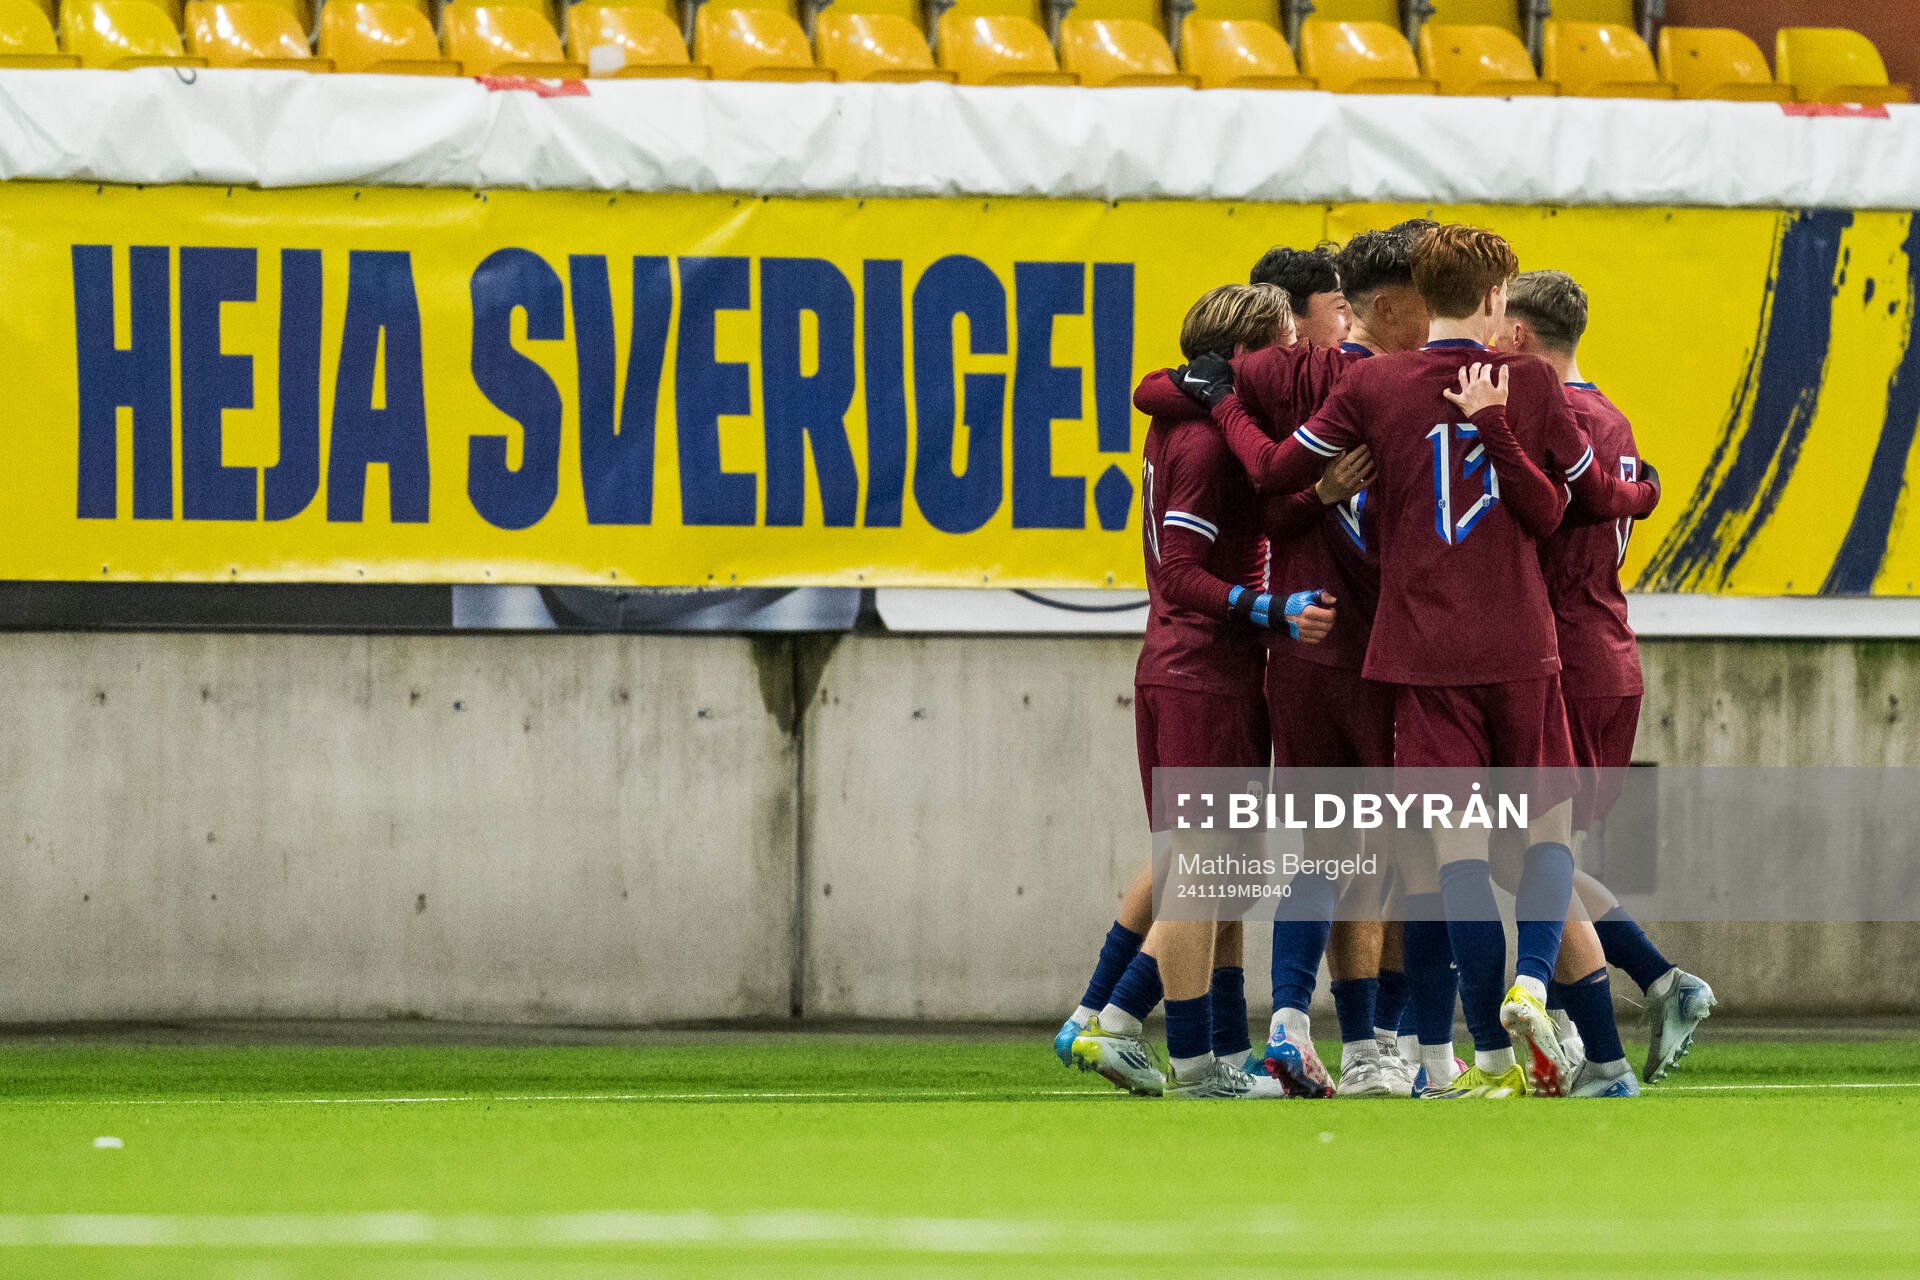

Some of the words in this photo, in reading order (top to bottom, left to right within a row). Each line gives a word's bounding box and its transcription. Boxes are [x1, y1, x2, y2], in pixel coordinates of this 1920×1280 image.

[71, 244, 430, 523] HEJA
[467, 247, 1135, 533] SVERIGE!
[1425, 423, 1501, 545] 13
